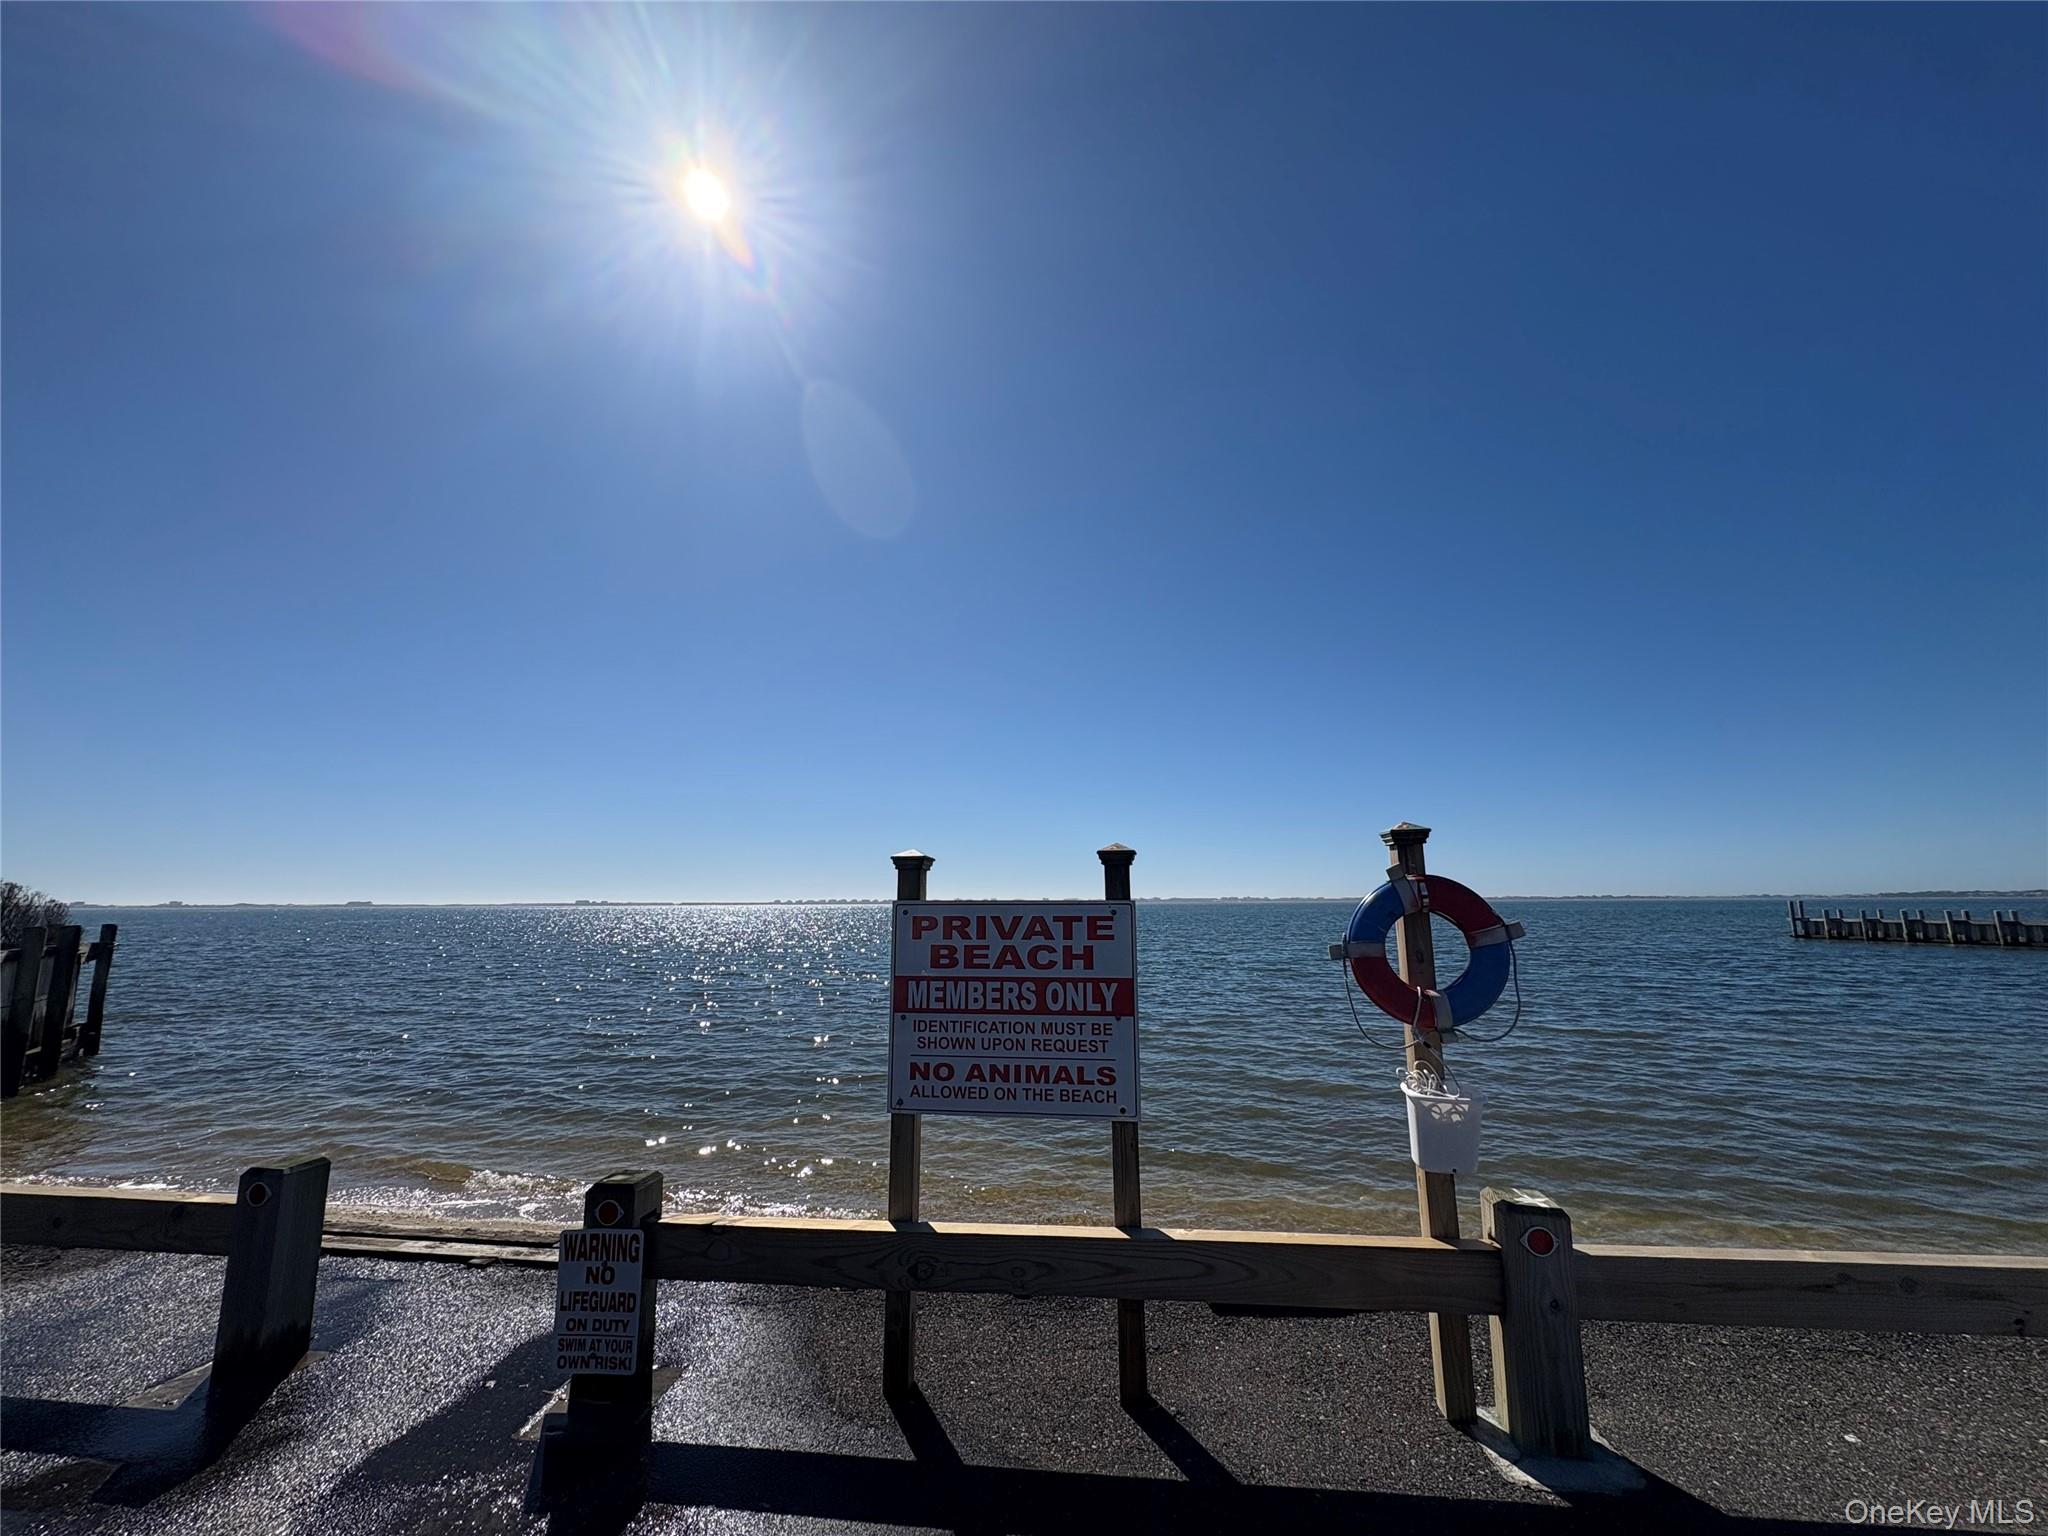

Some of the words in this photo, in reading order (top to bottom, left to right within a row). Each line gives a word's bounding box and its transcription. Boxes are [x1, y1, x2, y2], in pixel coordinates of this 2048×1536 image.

[911, 915, 1115, 941] PRIVATE
[930, 944, 1094, 970] BEACH
[908, 980, 1037, 1011] MEMBERS
[1046, 982, 1119, 1012] ONLY
[913, 1020, 1036, 1035] IDENTIFICATION
[1041, 1022, 1086, 1036] MUST
[1091, 1023, 1113, 1036] BE
[917, 1036, 976, 1050] SHOWN
[981, 1038, 1026, 1051] UPON
[1031, 1038, 1109, 1053] REQUEST
[909, 1062, 955, 1082] NO
[964, 1064, 1117, 1086] ANIMALS
[910, 1085, 989, 1100] ALLOWED
[994, 1087, 1018, 1101] ON
[1022, 1087, 1054, 1102] THE
[1059, 1089, 1117, 1104] BEACH
[563, 1233, 640, 1263] WARNING
[585, 1266, 615, 1285] NO
[559, 1291, 637, 1313] LIFEGUARD
[565, 1318, 587, 1332] ON
[592, 1319, 630, 1333] DUTY
[558, 1338, 586, 1352] SWIM
[589, 1338, 602, 1353] AT
[604, 1339, 633, 1354] YOUR
[557, 1355, 591, 1370] OWN
[594, 1356, 632, 1371] RISK!
